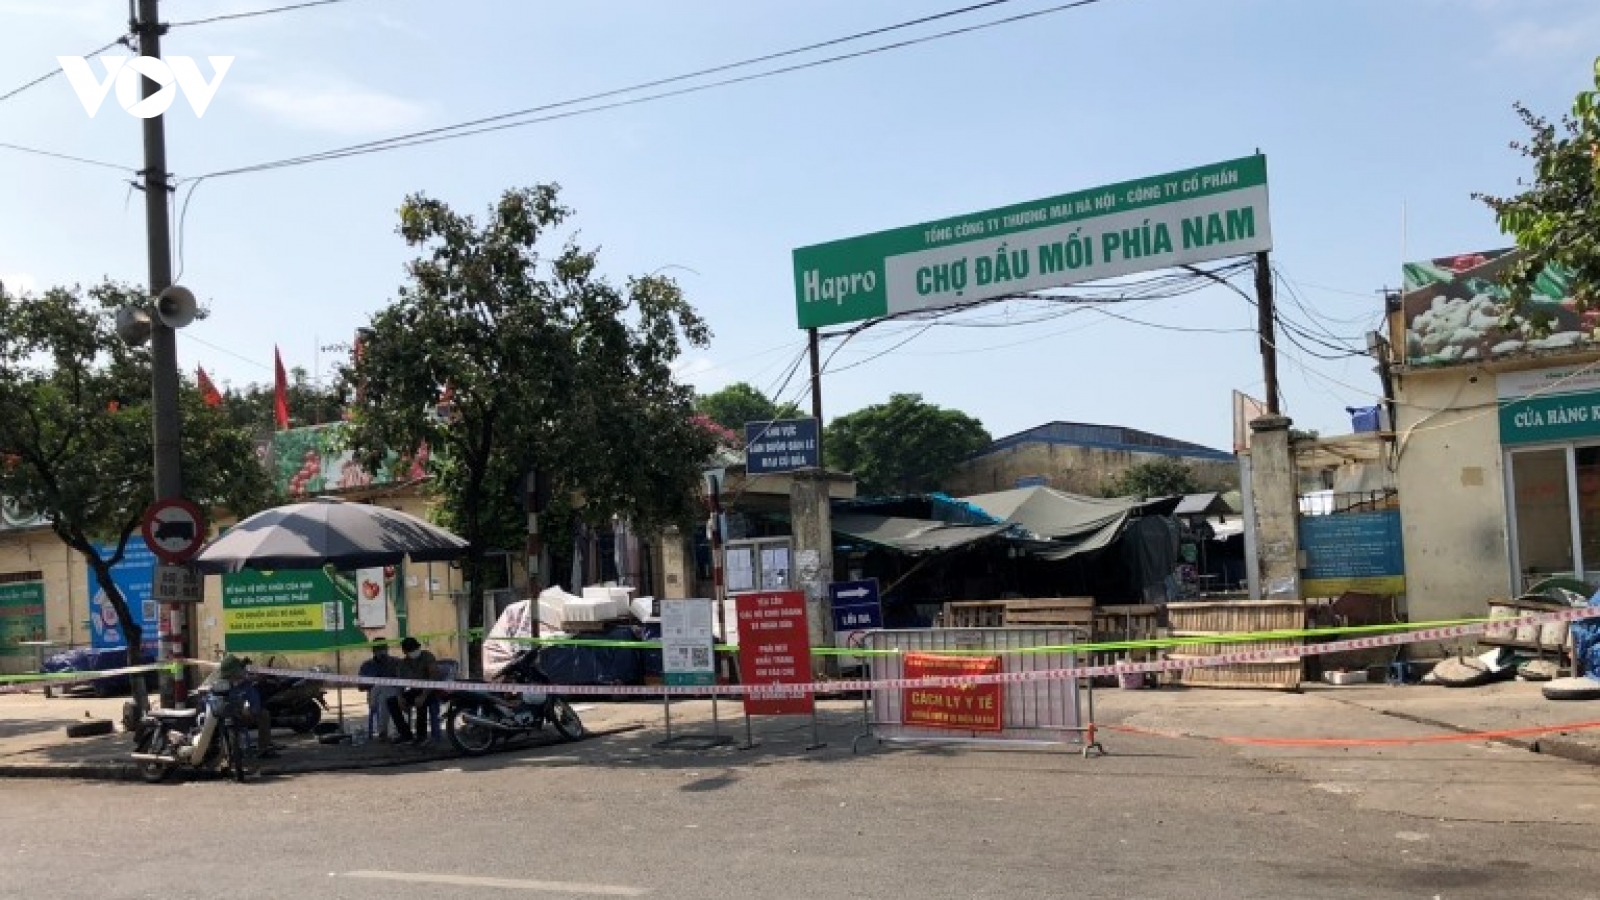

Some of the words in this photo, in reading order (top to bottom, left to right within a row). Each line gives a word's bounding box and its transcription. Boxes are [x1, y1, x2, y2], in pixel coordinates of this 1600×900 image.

[954, 220, 984, 238] CÔNG
[988, 218, 1000, 232] TY
[1050, 201, 1073, 220] MẠI
[1076, 197, 1093, 213] HÀ
[1095, 193, 1115, 211] NỘI
[1126, 185, 1161, 203] CÔNG
[1164, 182, 1178, 196] TY
[916, 257, 968, 297] CHỢ
[975, 241, 1030, 286] ĐẦU
[1039, 227, 1093, 276] MỐI
[1102, 218, 1174, 263] PHÍA
[1181, 206, 1255, 249] NAM
[803, 268, 876, 306] Hapro
[1514, 406, 1544, 427] CỬA
[1547, 404, 1588, 426] HÀNG
[912, 690, 943, 707] CÁCH
[978, 692, 993, 709] TẾ
